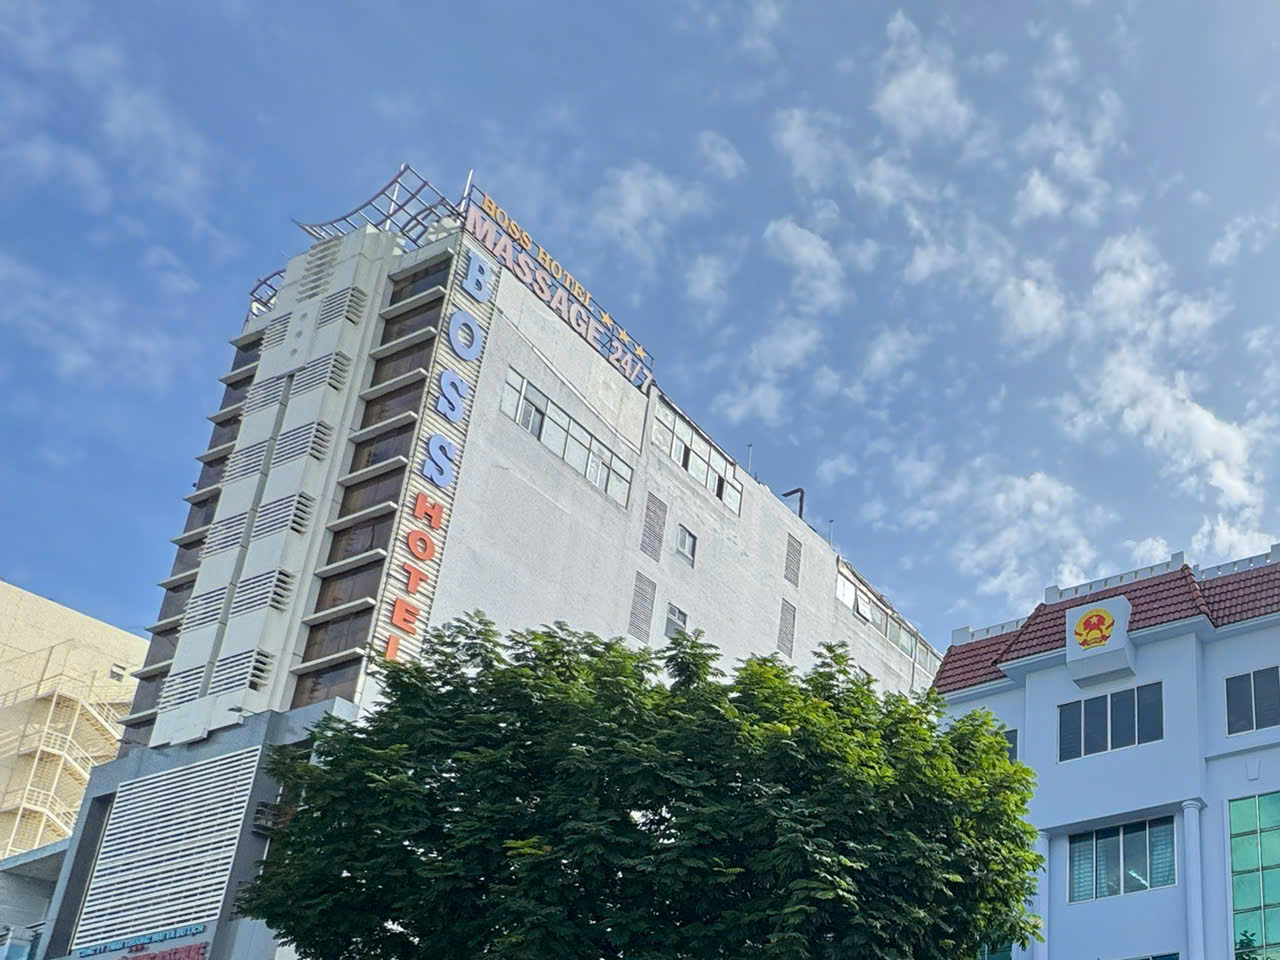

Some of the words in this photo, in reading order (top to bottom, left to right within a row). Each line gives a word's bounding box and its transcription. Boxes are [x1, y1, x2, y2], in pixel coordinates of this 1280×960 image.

[465, 205, 605, 349] MASSAGE
[608, 339, 654, 398] 24/7
[481, 192, 533, 250] BOSS
[536, 246, 595, 312] HOTEL
[422, 249, 492, 489] BOSS
